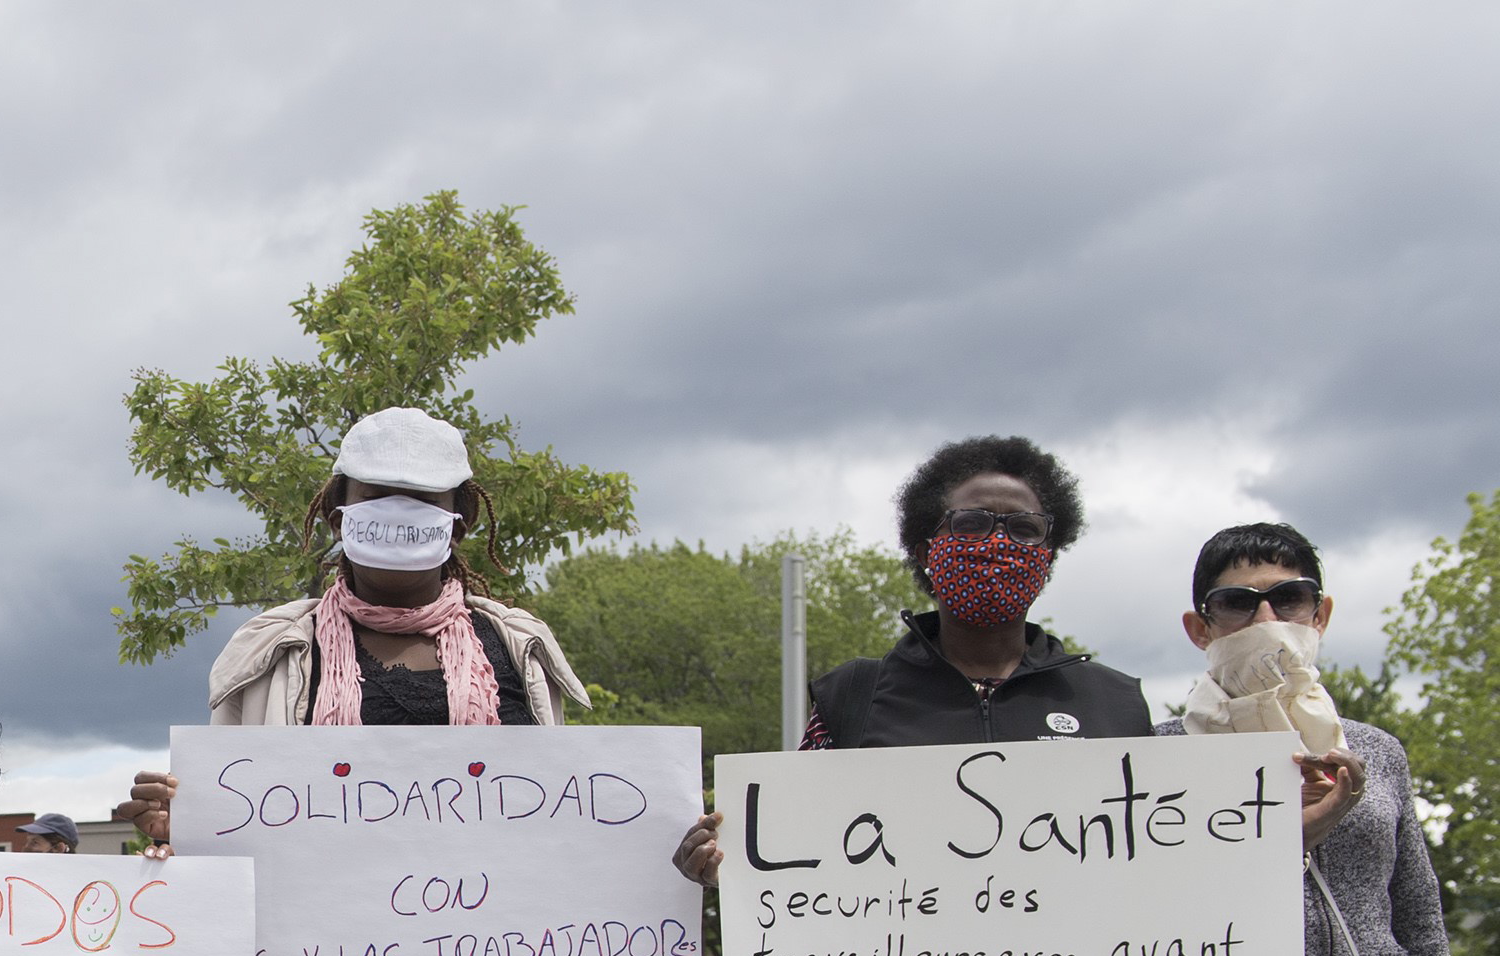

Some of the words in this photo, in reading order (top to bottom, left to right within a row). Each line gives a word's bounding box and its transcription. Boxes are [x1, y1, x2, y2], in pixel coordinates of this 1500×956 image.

[217, 758, 648, 836] SOLIDARIDAD
[745, 783, 897, 872] La
[947, 751, 1189, 863] Santé
[1207, 766, 1285, 843] et
[391, 872, 489, 916] CON
[757, 878, 940, 929] securité
[975, 875, 1040, 914] des
